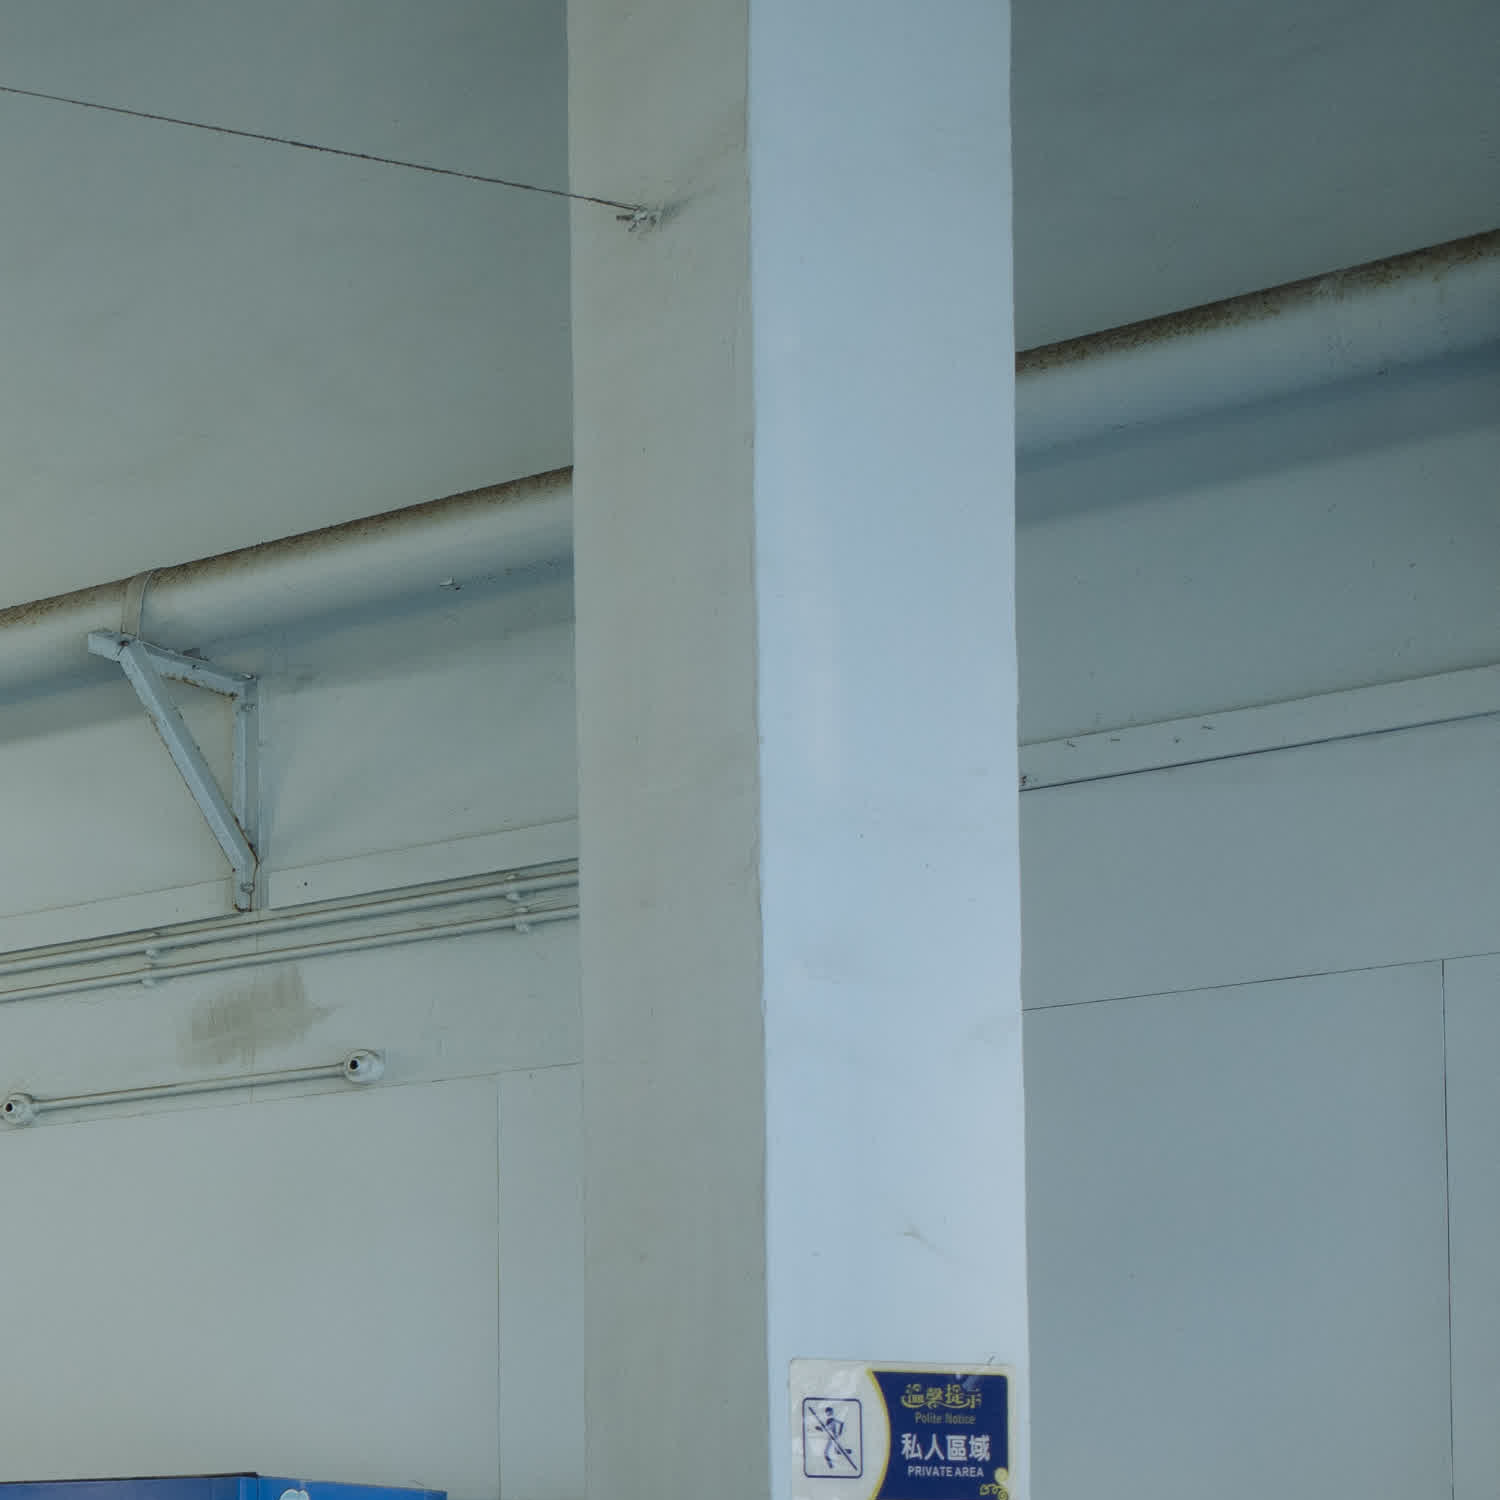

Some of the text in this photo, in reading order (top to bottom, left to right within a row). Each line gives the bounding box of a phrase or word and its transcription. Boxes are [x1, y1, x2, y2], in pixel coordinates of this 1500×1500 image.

[915, 1412, 976, 1425] Polite Notice
[901, 1433, 991, 1462] 私人區域
[908, 1466, 984, 1478] PRIVATE AREA
